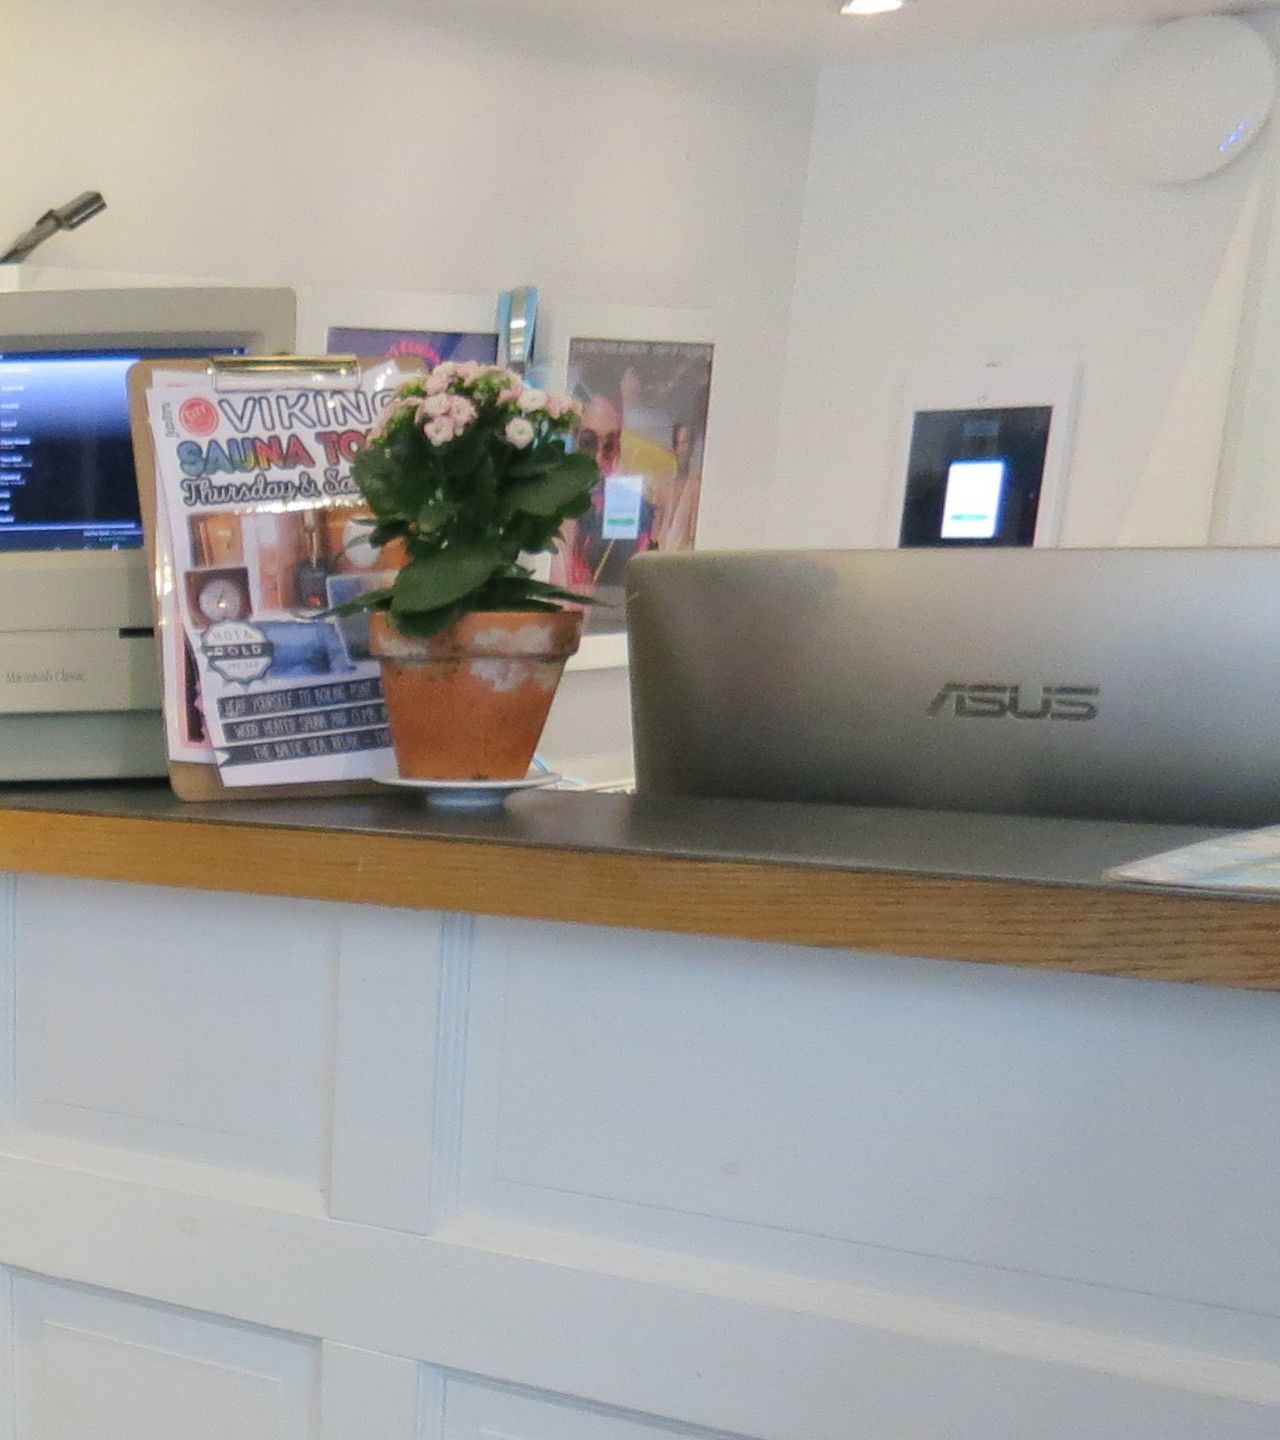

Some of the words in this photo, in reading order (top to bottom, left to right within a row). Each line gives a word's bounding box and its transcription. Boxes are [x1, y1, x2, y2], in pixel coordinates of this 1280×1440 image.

[176, 433, 316, 477] SAUNA
[180, 472, 299, 506] Thursday
[299, 472, 321, 498] &
[926, 681, 1100, 721] ASUS
